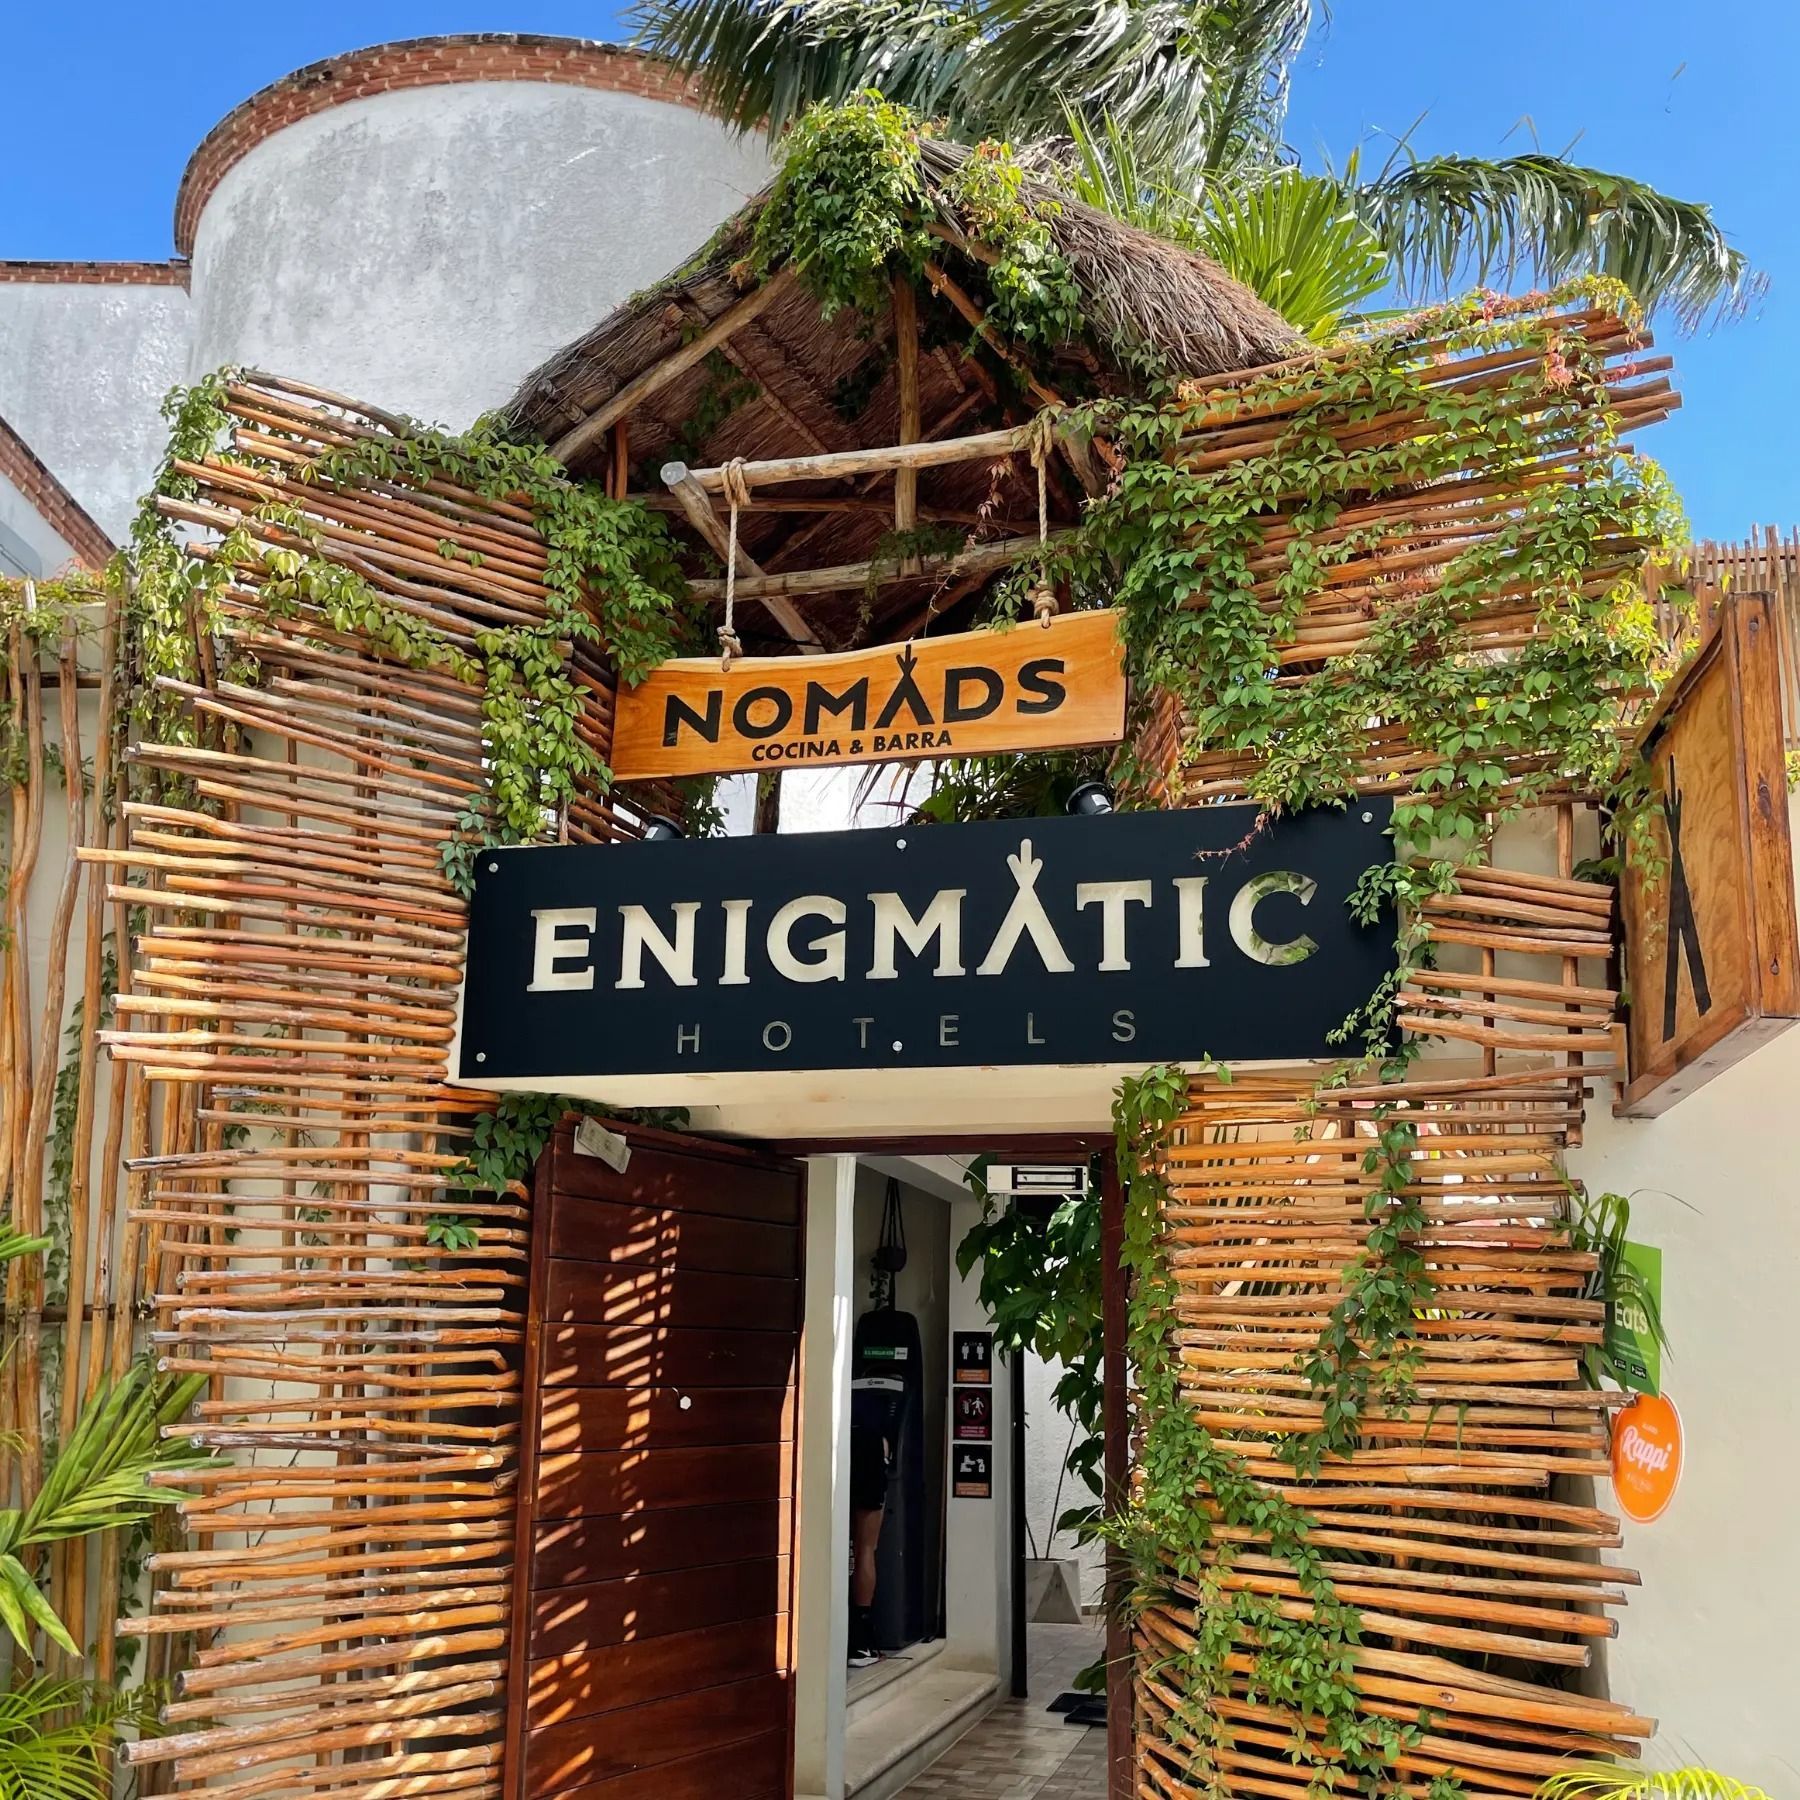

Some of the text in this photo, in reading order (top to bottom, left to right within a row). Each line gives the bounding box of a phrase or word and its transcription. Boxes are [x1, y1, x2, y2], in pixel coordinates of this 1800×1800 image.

[662, 645, 1067, 747] NOMADS
[752, 730, 952, 762] COCINA & BARRA
[526, 838, 1320, 992] ENIGMATIC
[677, 1009, 1137, 1054] HOTELS
[1614, 1297, 1649, 1336] Eats
[1622, 1425, 1673, 1474] Rappi
